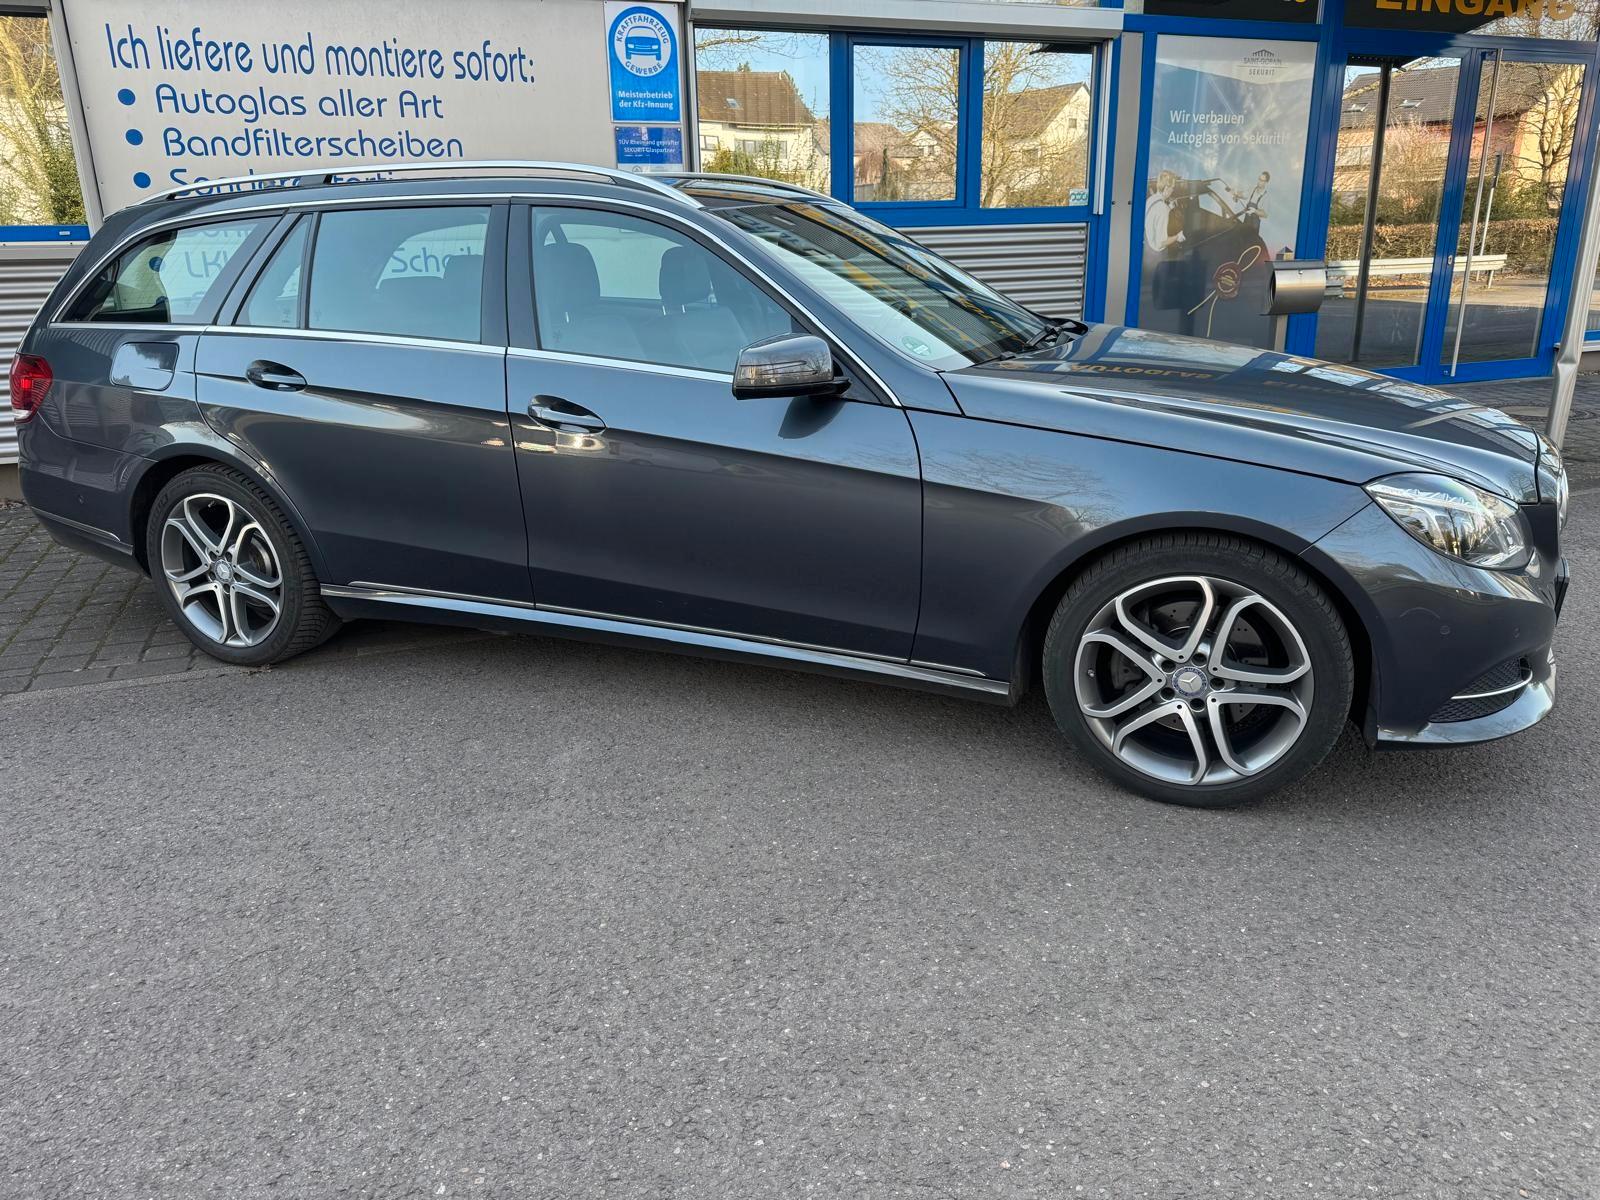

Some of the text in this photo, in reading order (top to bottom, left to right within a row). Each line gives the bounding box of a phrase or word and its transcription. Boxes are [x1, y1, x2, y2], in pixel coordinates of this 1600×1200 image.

[616, 15, 669, 44] KRAFTFAHRZEUG
[105, 23, 535, 84] Ich liefere und montiere sofort:
[625, 60, 663, 75] GEWERBE
[155, 83, 444, 123] Autoglas aller Art
[618, 90, 673, 99] Meisterbetrieb
[619, 100, 673, 110] der Kfz-Innung
[1169, 110, 1245, 125] Wir verbauen
[163, 127, 464, 157] Bandfilterscheiben
[1167, 130, 1218, 148] Autoglas
[1220, 135, 1240, 144] von
[184, 249, 230, 278] LK
